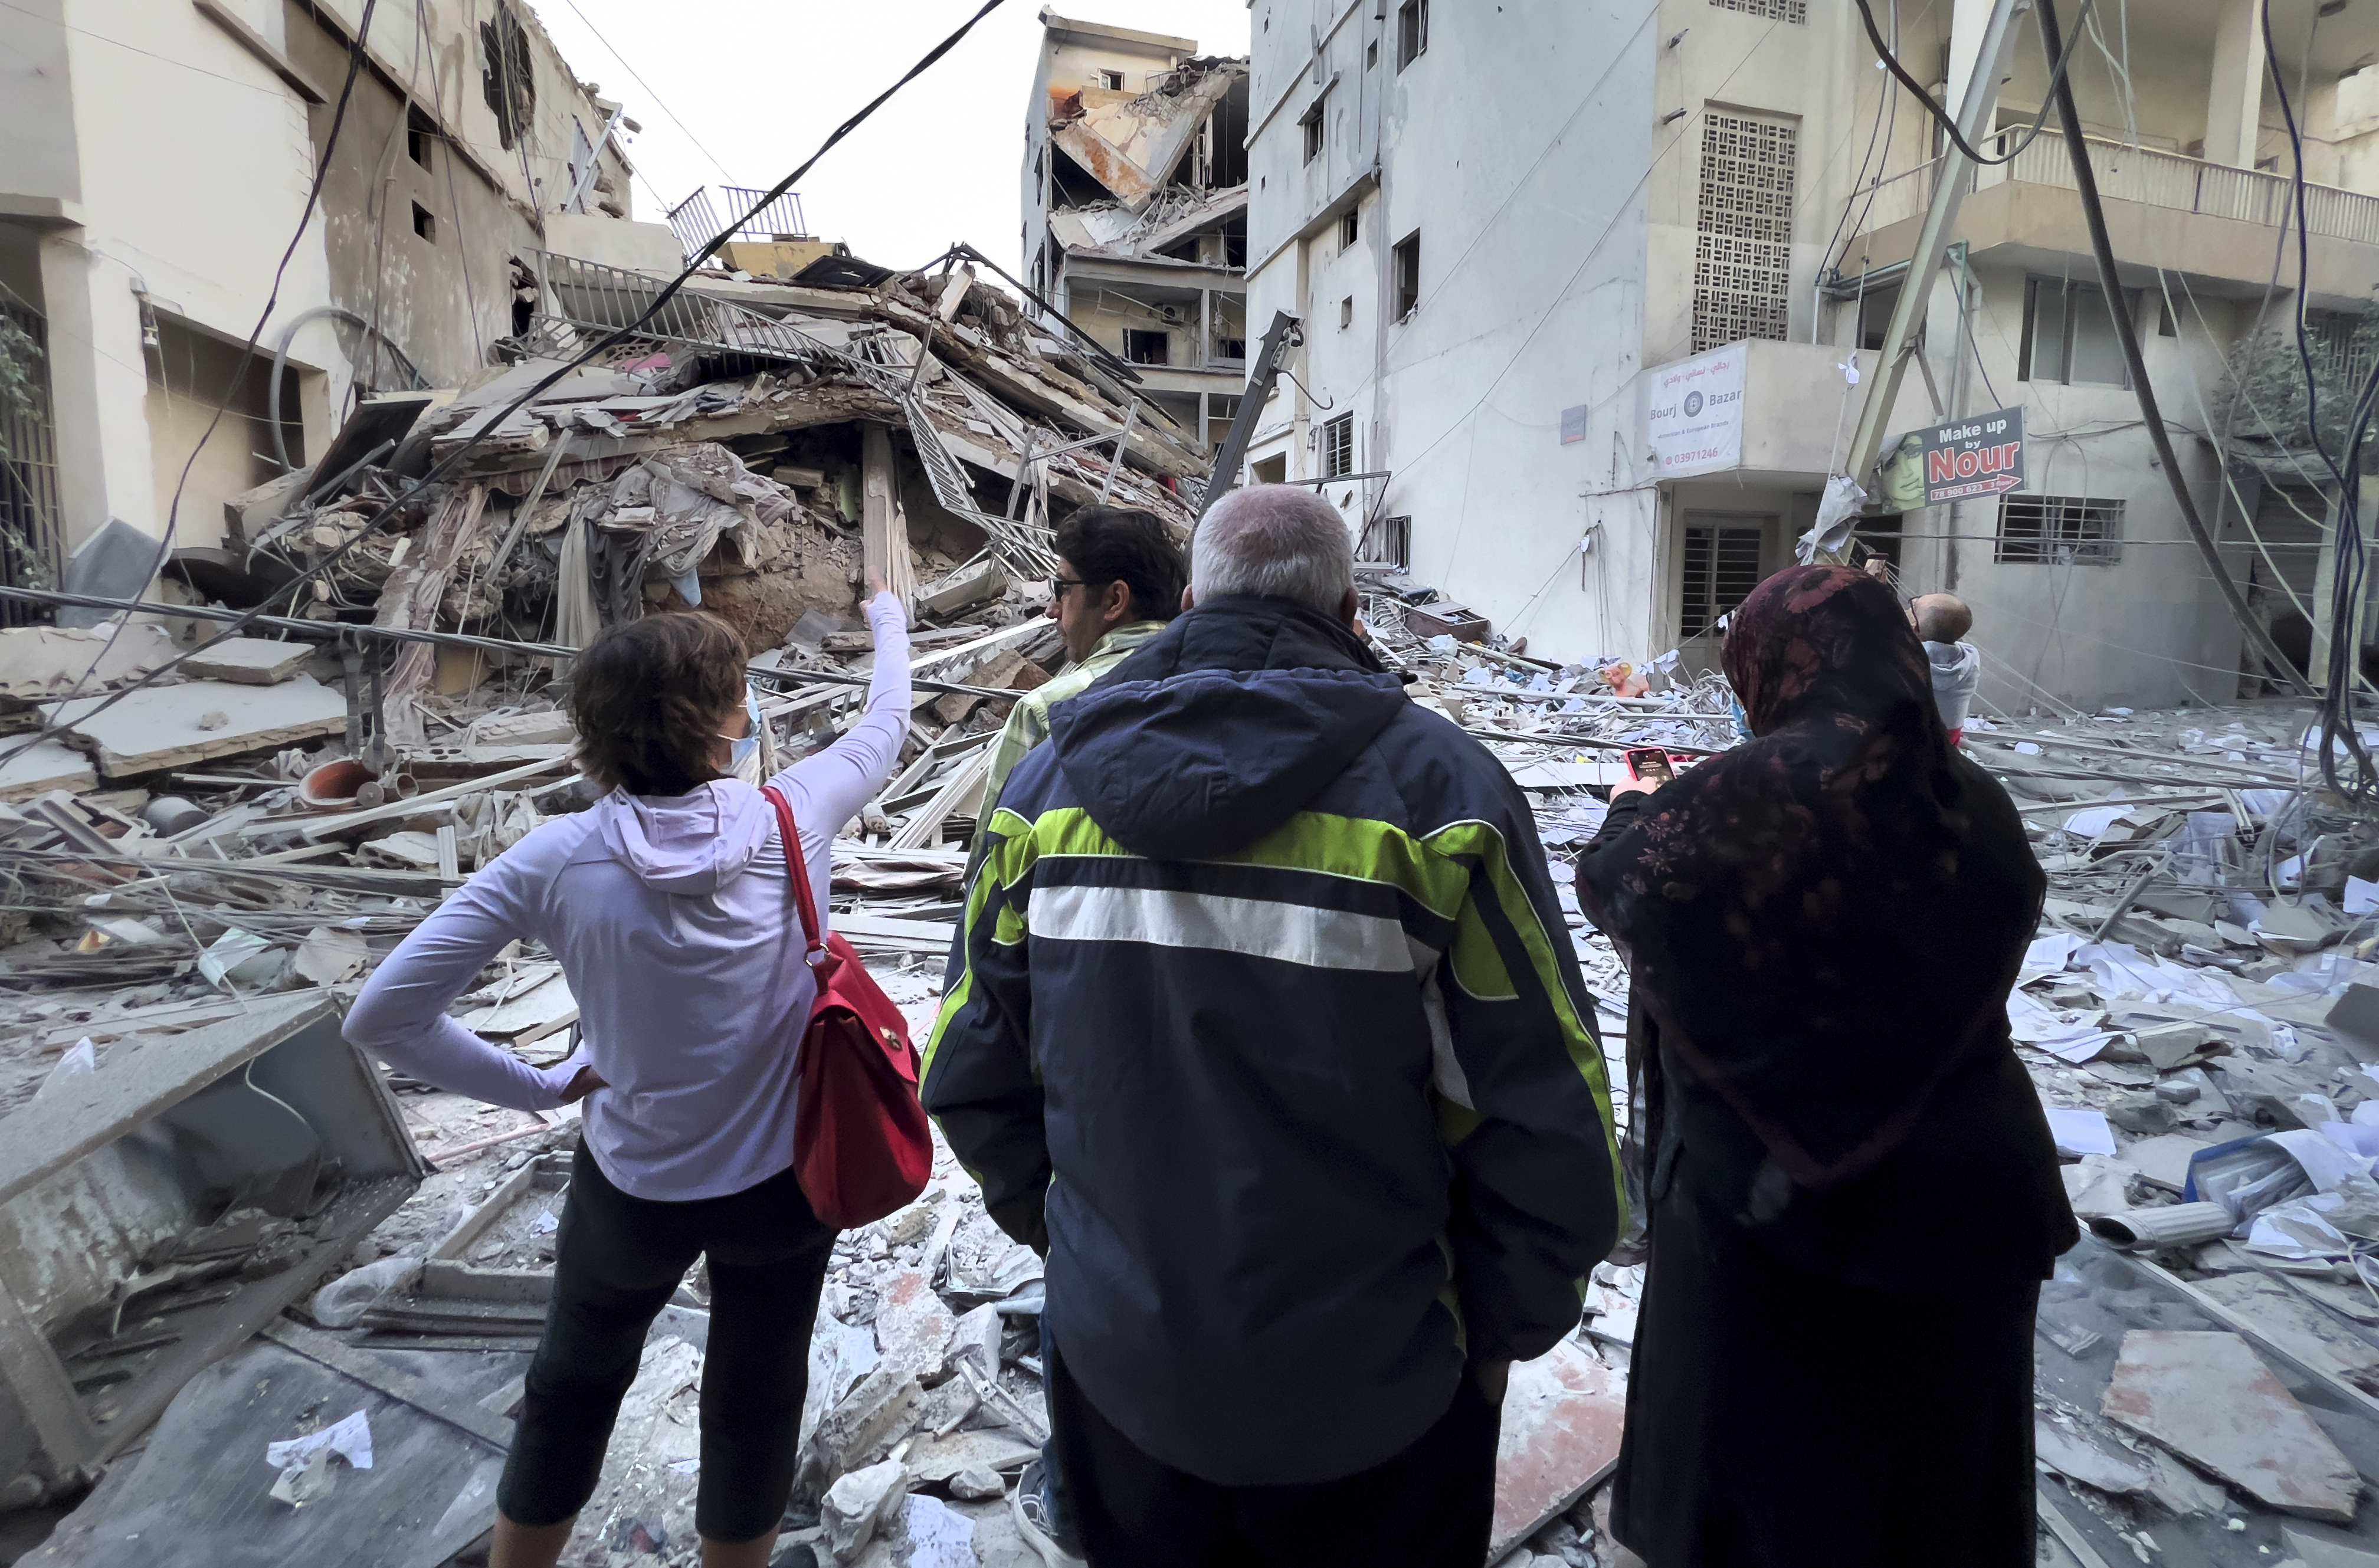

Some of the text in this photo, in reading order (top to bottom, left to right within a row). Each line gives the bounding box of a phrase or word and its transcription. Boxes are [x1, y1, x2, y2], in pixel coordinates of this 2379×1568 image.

[1650, 390, 1742, 420] Bourj Bazar
[1687, 425, 1710, 434] European
[1939, 419, 2007, 443] Make up
[1965, 440, 1981, 449] by
[1675, 447, 1718, 464] 03971246
[1928, 441, 2021, 483] Nour
[1947, 488, 1964, 496] 900
[1966, 484, 1983, 493] 623
